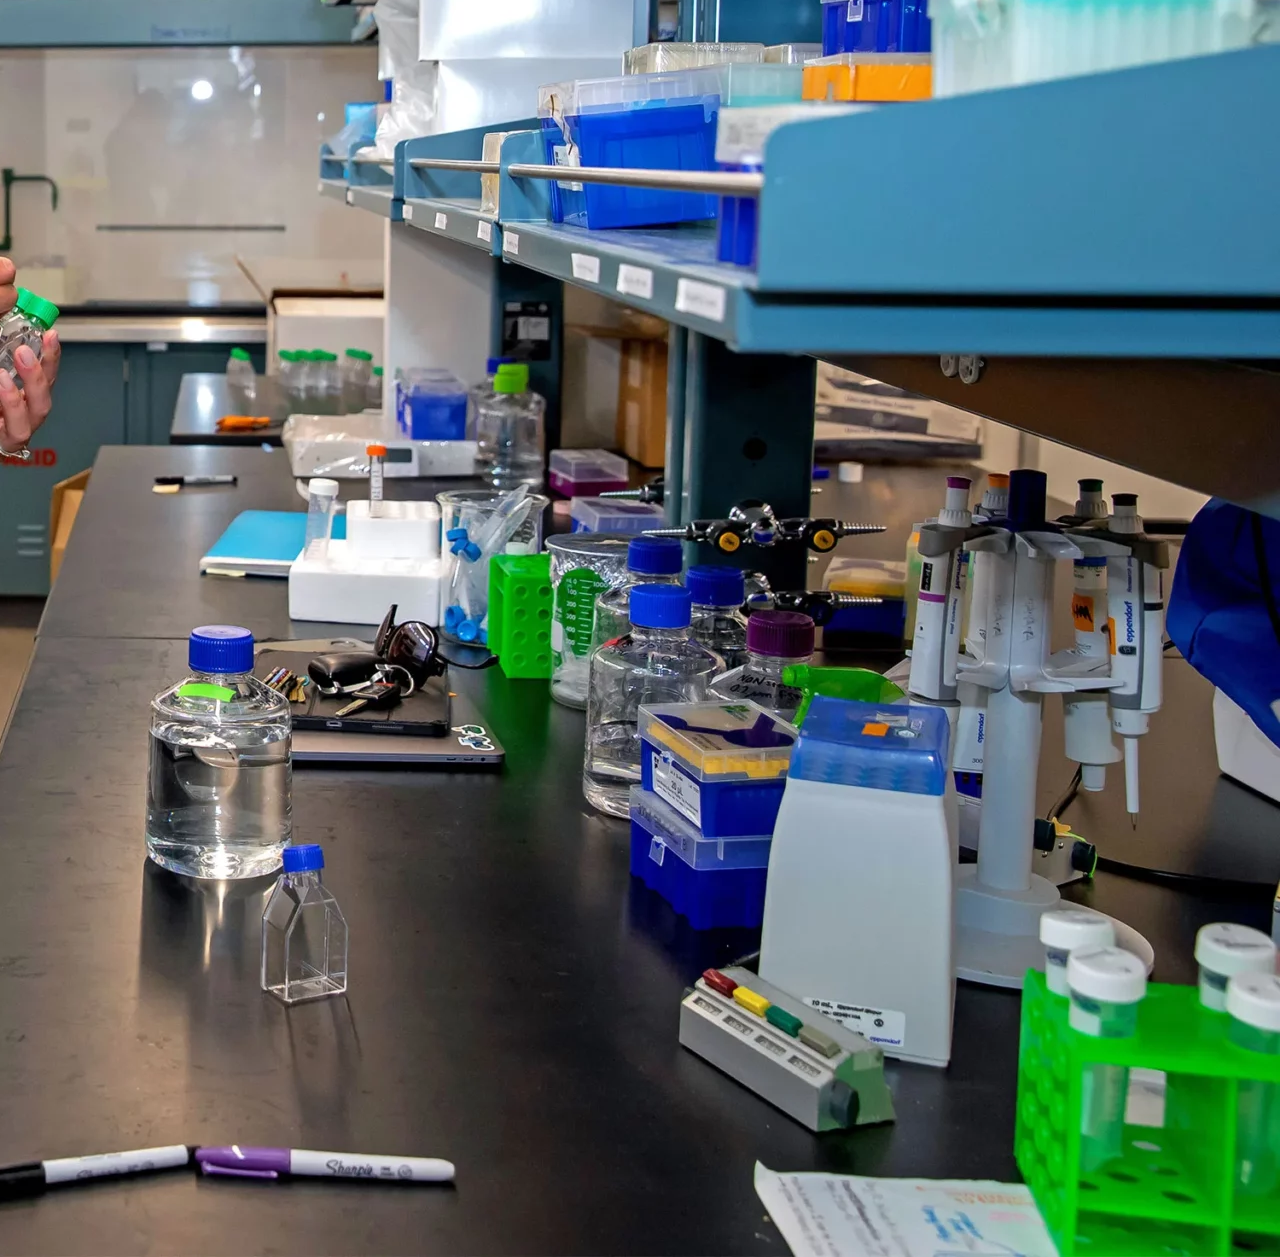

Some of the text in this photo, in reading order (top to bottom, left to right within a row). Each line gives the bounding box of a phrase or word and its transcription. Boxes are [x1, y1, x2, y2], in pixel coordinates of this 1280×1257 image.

[1125, 600, 1134, 643] eppendorf
[870, 1036, 901, 1044] eppendorf
[326, 1159, 377, 1178] Sharpie
